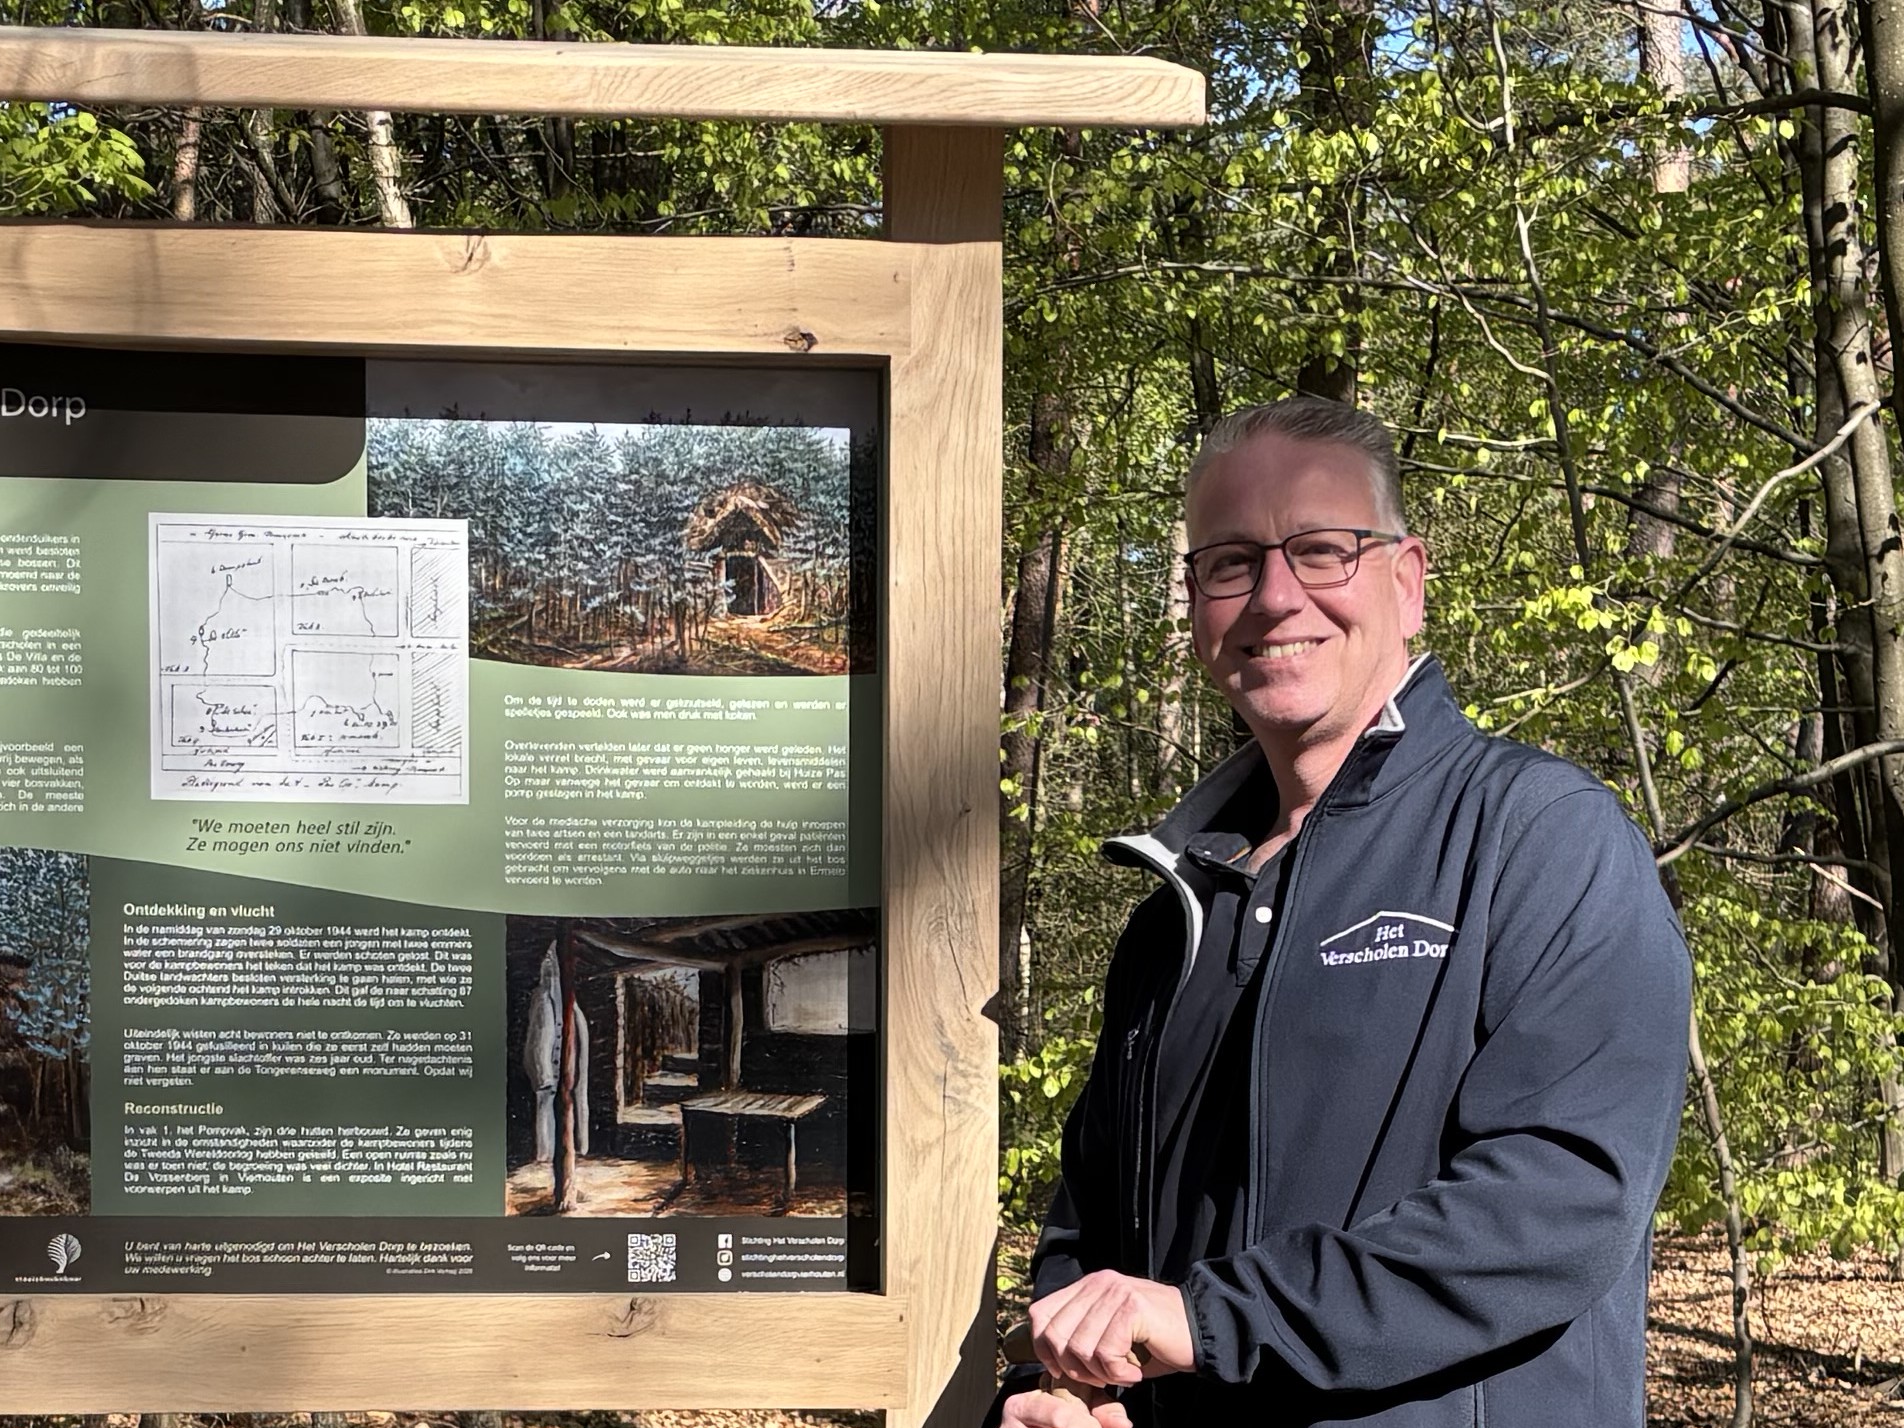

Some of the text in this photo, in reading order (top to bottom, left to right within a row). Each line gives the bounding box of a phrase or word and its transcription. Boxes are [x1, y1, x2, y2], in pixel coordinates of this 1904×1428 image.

[1, 388, 86, 425] Dorp
[227, 821, 291, 834] moeten
[296, 819, 332, 834] heel
[336, 820, 360, 835] stil
[364, 822, 396, 839] zijn.
[186, 837, 207, 852] Ze
[213, 840, 270, 856] mogen
[276, 842, 304, 853] ons
[309, 840, 340, 853] niet
[124, 903, 274, 919] Ontdekking en vlucht
[1374, 924, 1404, 942] Het
[1320, 940, 1449, 966] Verscholen Dor
[124, 1102, 224, 1115] Reconstructie
